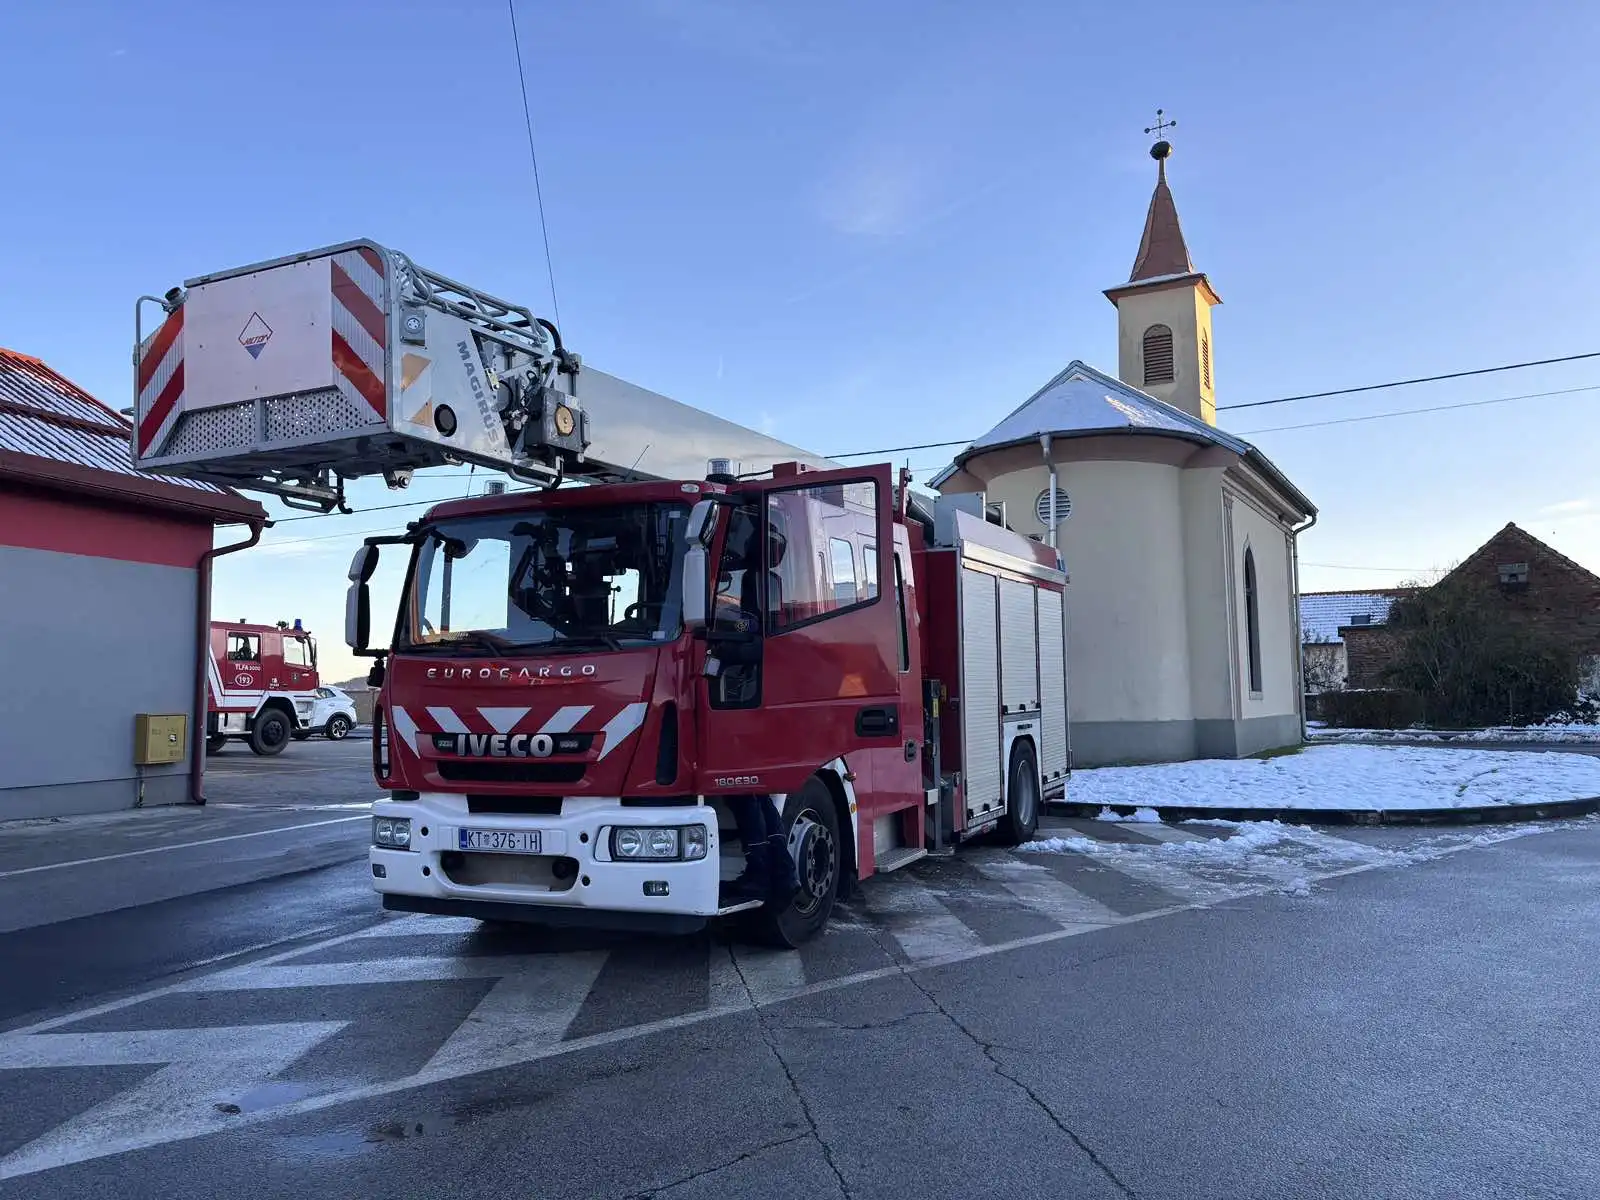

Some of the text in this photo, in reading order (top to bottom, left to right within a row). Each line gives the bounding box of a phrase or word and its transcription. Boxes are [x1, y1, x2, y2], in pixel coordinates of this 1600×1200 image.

[457, 340, 499, 443] MAGIRUS
[239, 676, 250, 684] 193
[427, 664, 595, 679] EUROCARGO
[457, 734, 553, 758] IVECO
[714, 775, 759, 787] 180E30
[468, 831, 538, 850] KT 376-IH
